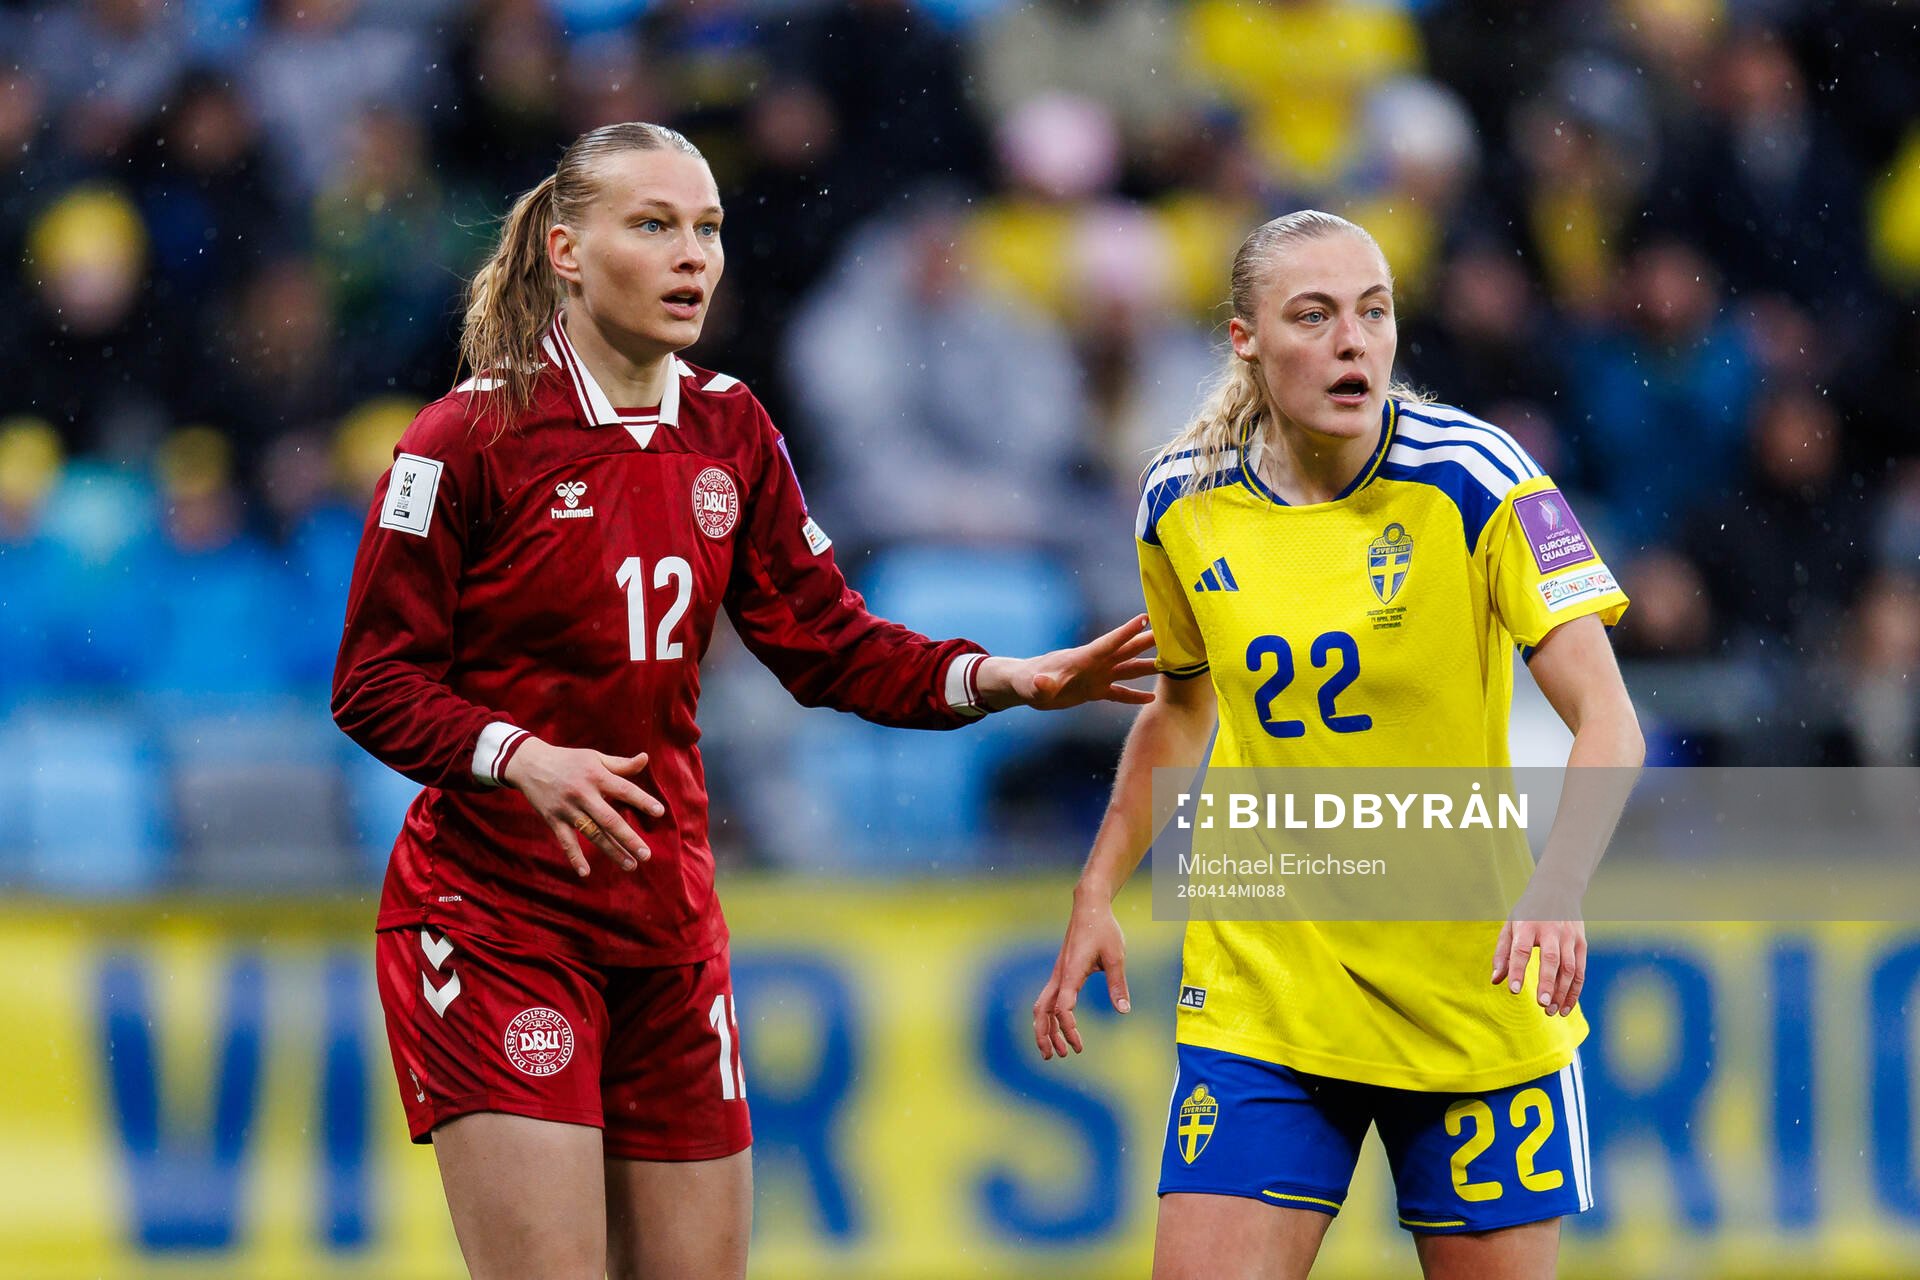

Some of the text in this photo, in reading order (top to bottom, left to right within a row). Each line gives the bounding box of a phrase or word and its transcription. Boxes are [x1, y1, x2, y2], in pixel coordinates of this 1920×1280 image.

[703, 491, 728, 513] DBU
[551, 506, 593, 519] hummel
[1375, 546, 1407, 555] SVERIGE
[1539, 534, 1582, 553] EUROPEAN
[1541, 542, 1586, 562] QUALIFIERS
[1540, 580, 1559, 593] UEFA
[615, 556, 693, 661] 12
[1246, 631, 1373, 738] 22
[507, 1029, 526, 1068] DANSK
[559, 1027, 572, 1064] UNION
[519, 1030, 560, 1052] DBU
[529, 1063, 557, 1074] 1889
[1184, 1106, 1212, 1114] SVERIGE
[1445, 1087, 1564, 1202] 22
